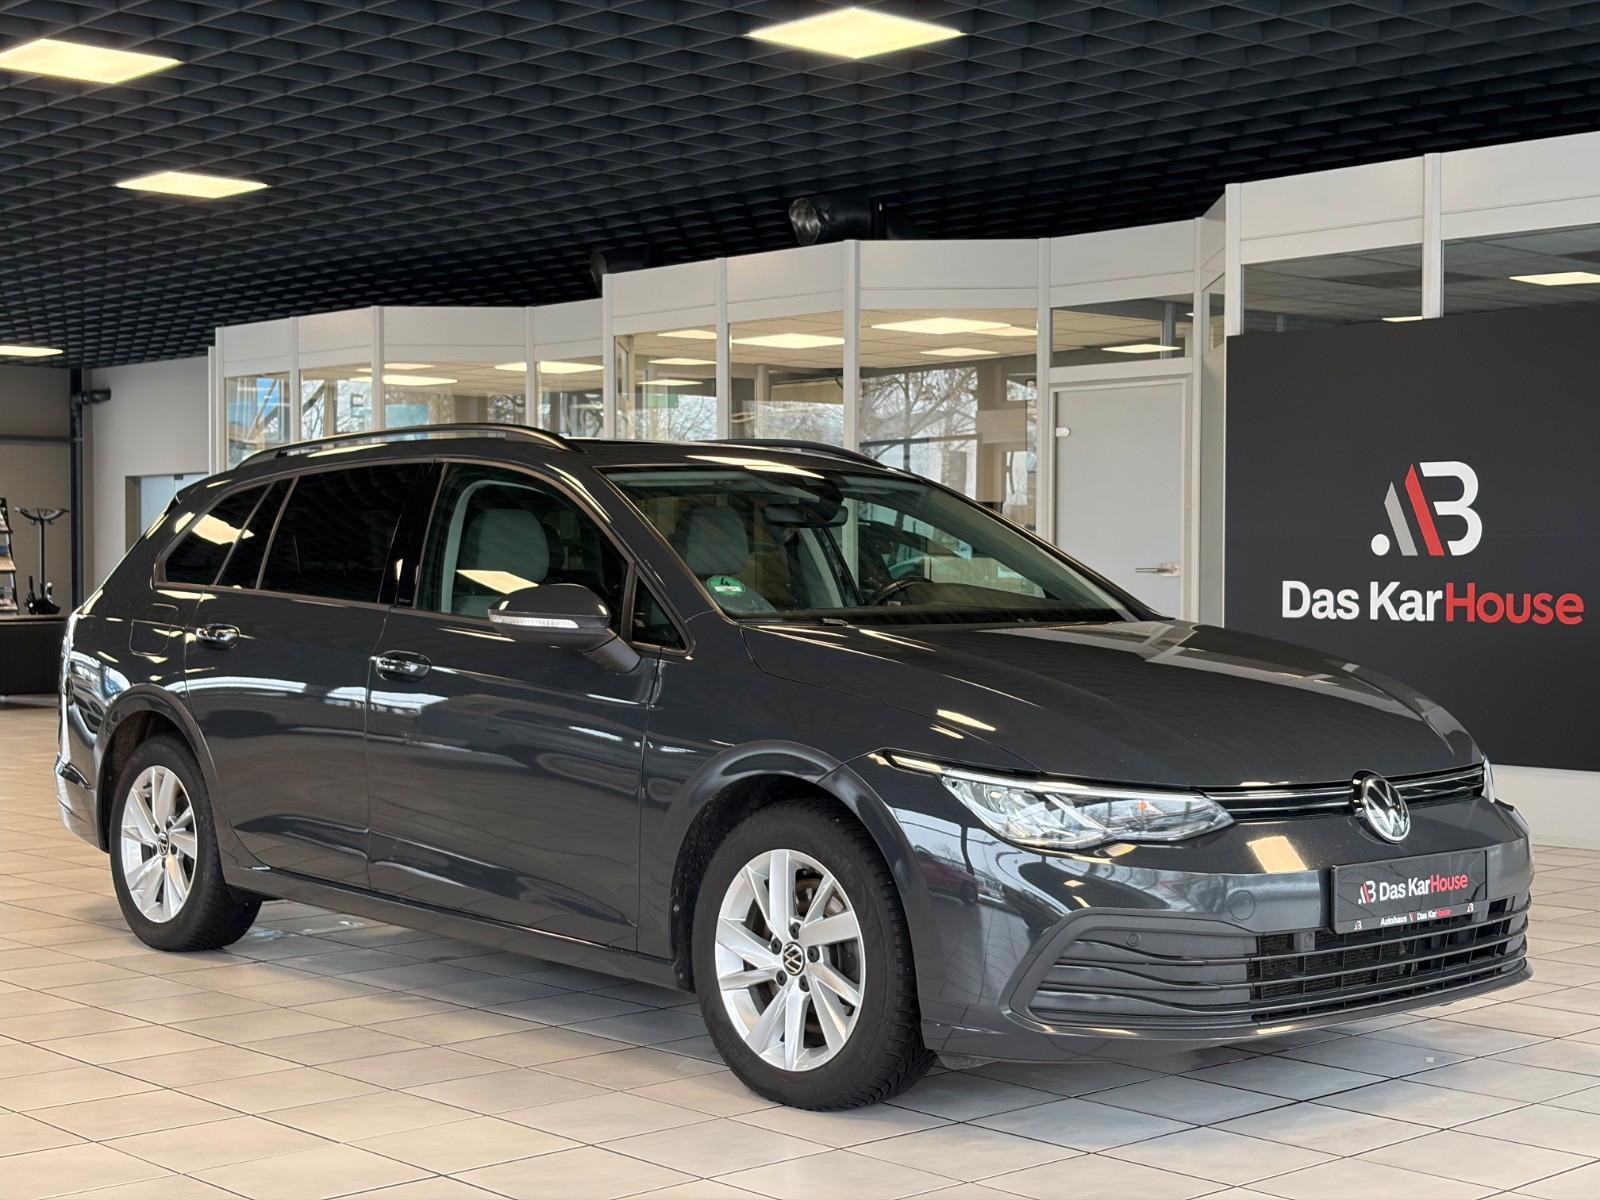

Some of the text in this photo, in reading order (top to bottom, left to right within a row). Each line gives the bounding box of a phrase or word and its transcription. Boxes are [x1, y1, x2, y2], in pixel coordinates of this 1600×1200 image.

[1281, 580, 1585, 626] Das KarHouse
[1379, 881, 1406, 902] Das
[1408, 874, 1468, 897] KarHouse
[1380, 915, 1408, 926] Autohaus
[1417, 911, 1428, 921] Das
